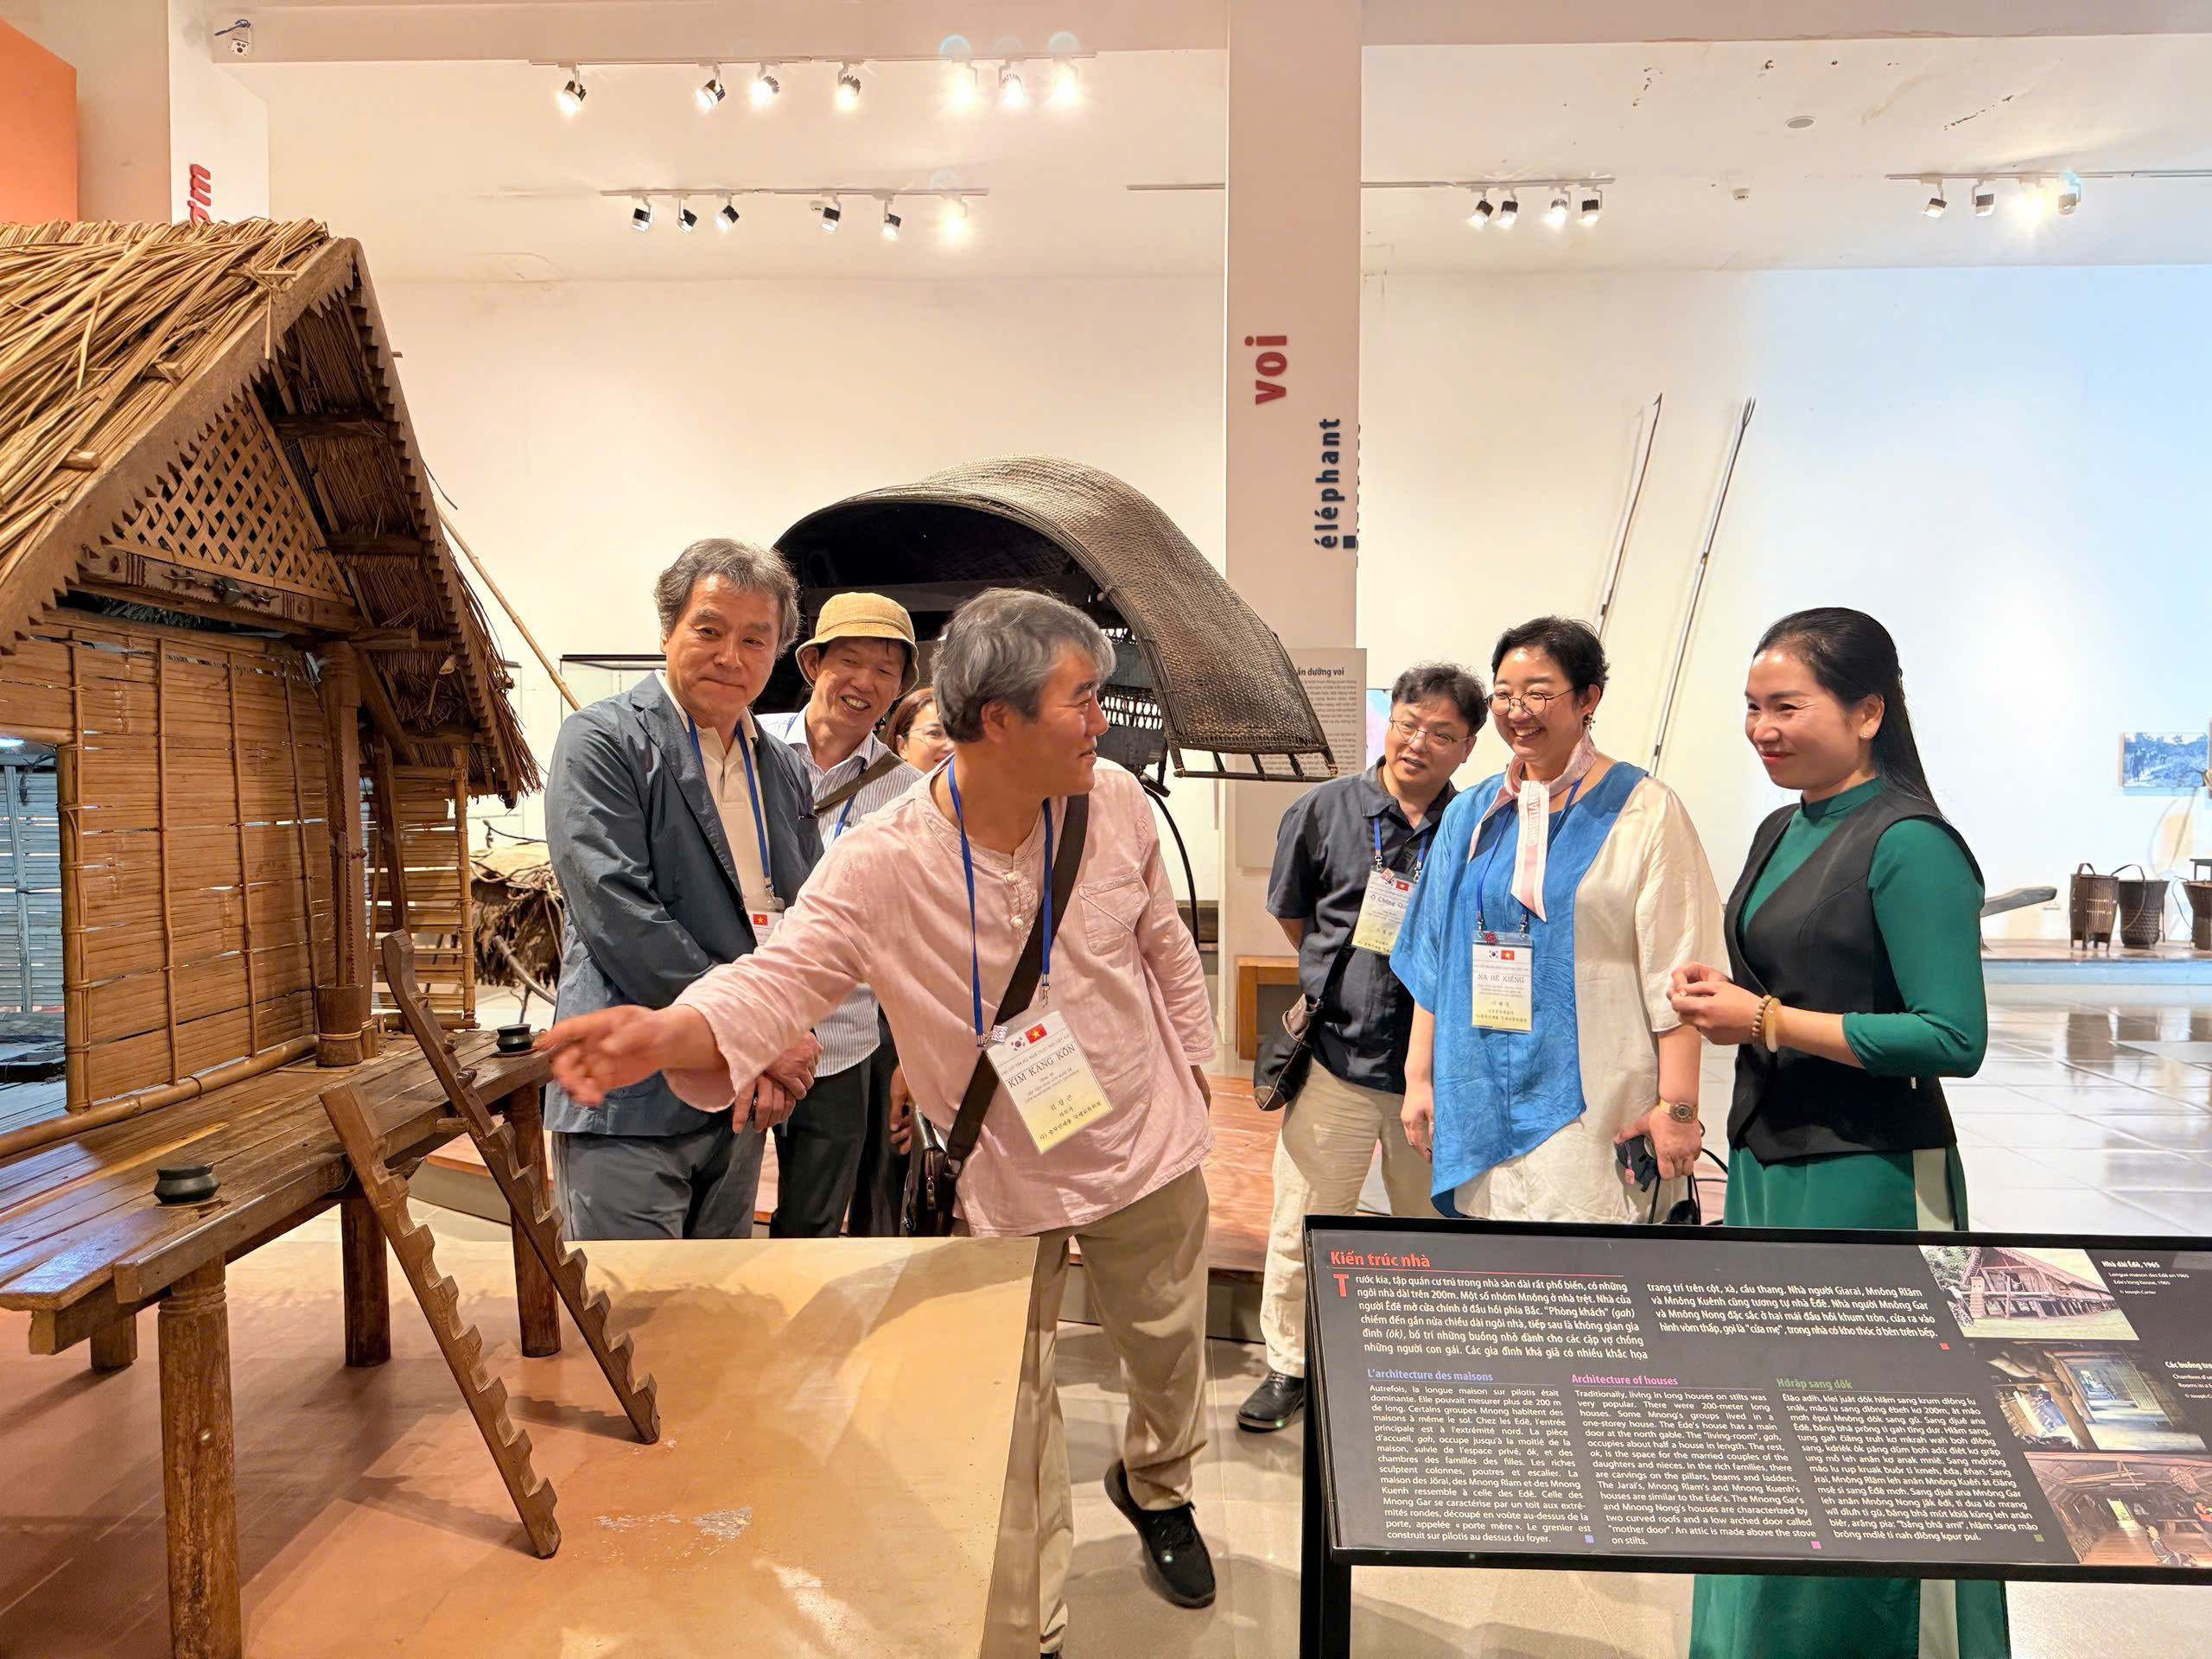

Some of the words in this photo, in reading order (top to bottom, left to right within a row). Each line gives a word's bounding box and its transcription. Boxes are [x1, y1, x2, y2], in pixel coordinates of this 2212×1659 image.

[1244, 335, 1288, 404] voi
[1314, 418, 1345, 549] éléphant
[1307, 666, 1332, 678] dưỡng
[1333, 666, 1344, 676] voi
[1007, 1073, 1027, 1089] KIM
[1028, 1057, 1054, 1077] KANG
[1330, 1250, 1364, 1266] Kiến
[1367, 1253, 1398, 1267] trúc
[1401, 1253, 1431, 1268] nhà
[1435, 1370, 1452, 1381] des
[1453, 1371, 1494, 1382] maisons
[1571, 1374, 1631, 1385] Architecture
[1632, 1375, 1643, 1385] of
[1643, 1375, 1678, 1386] houses
[1370, 1384, 1407, 1394] Autrefois,
[1425, 1386, 1453, 1395] longue
[1808, 1380, 1833, 1390] sang
[1370, 1394, 1416, 1402] dominante.
[1503, 1398, 1521, 1407] plus
[1574, 1389, 1628, 1400] Traditionally,
[1629, 1391, 1652, 1400] living
[1663, 1391, 1683, 1401] long
[1602, 1401, 1637, 1409] popular.
[1750, 1403, 1770, 1412] long
[1624, 1536, 1649, 1545] stilts.
